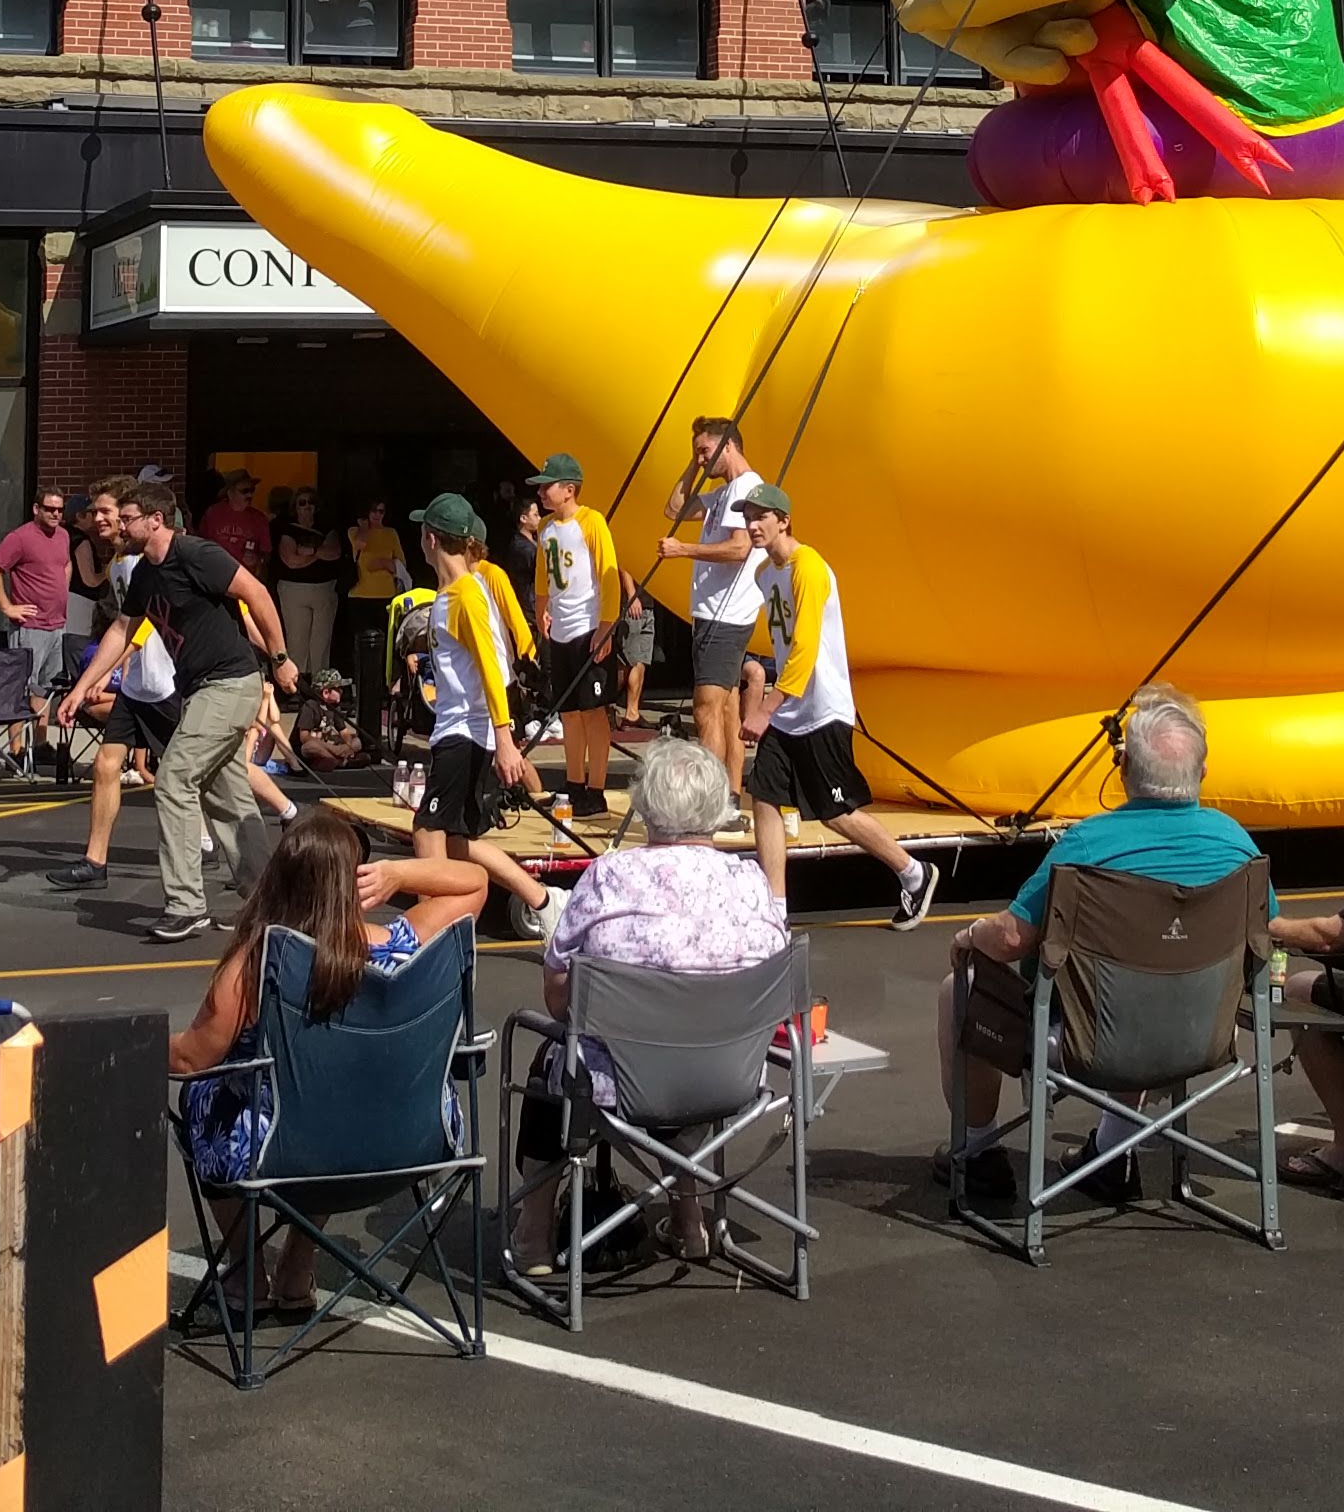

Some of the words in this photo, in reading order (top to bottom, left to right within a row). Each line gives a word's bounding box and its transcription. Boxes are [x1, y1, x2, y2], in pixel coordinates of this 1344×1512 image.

[188, 248, 341, 288] CON
[594, 681, 602, 696] 8
[429, 797, 439, 812] 6
